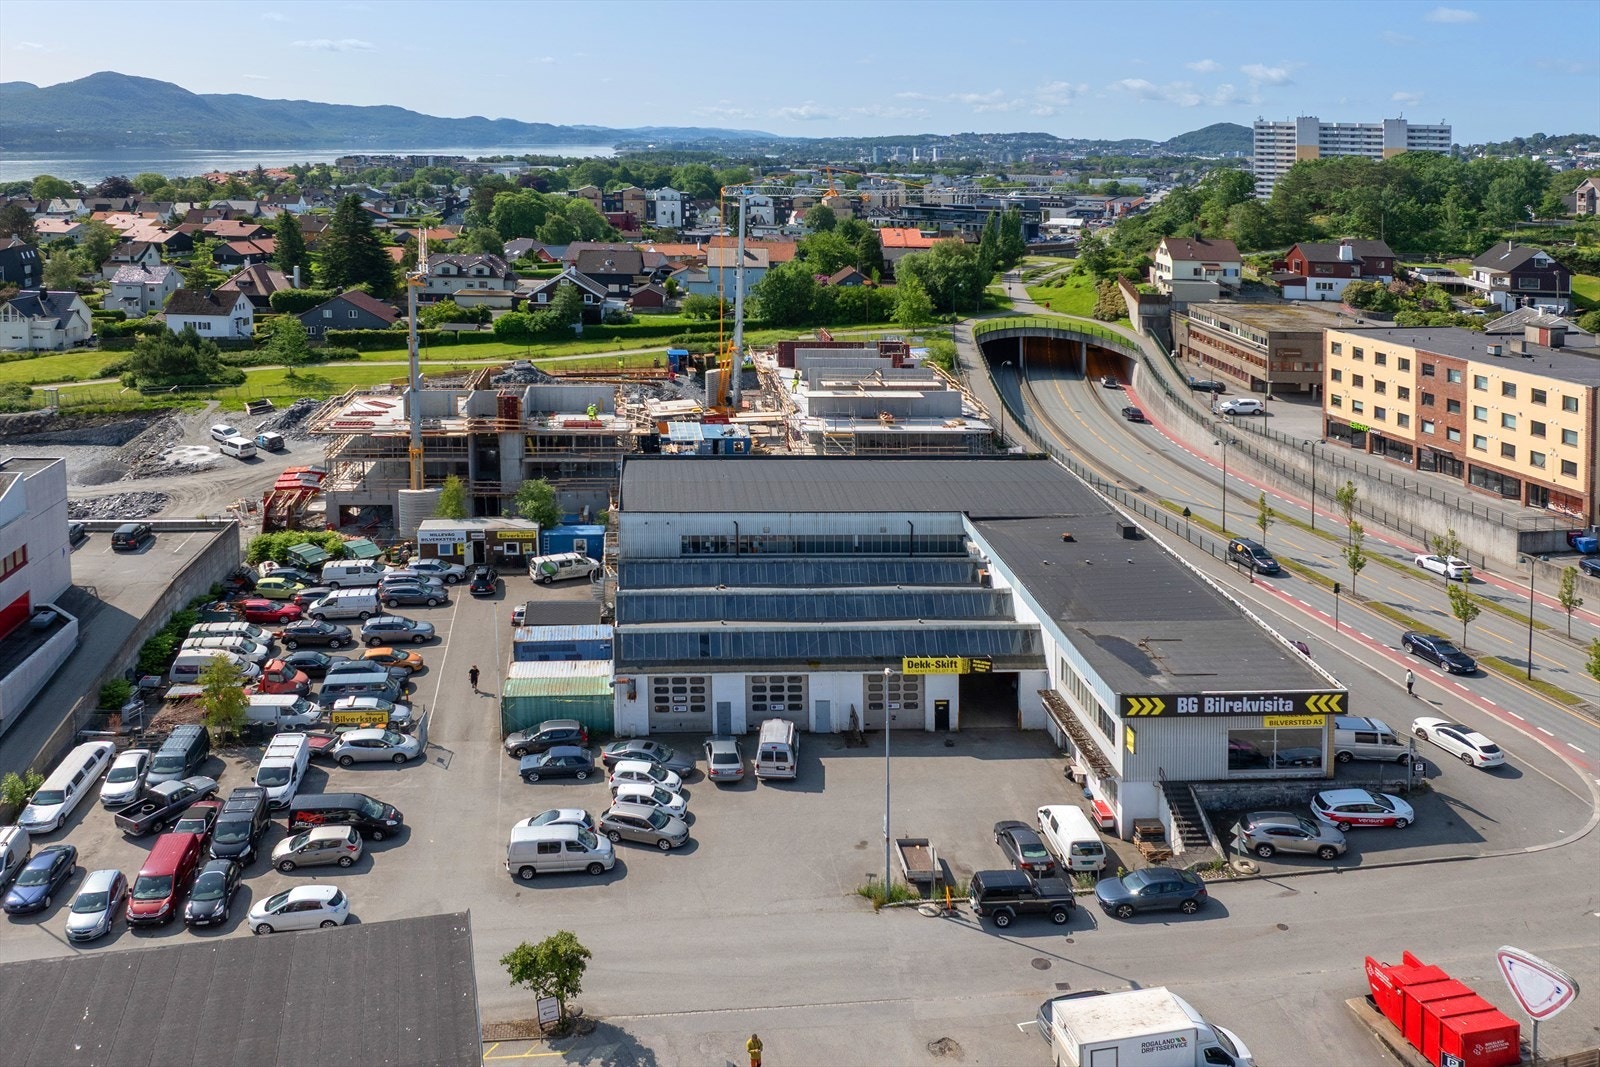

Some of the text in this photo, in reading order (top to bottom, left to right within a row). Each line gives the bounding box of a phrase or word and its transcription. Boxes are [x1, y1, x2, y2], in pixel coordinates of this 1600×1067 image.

[907, 660, 958, 669] Dekk-Skift
[1177, 696, 1294, 713] BG Bilrekvisita
[334, 715, 384, 723] Bilverksted
[1141, 1038, 1175, 1048] ROGALAND
[1141, 1042, 1187, 1053] DRIFTSSERVICE
